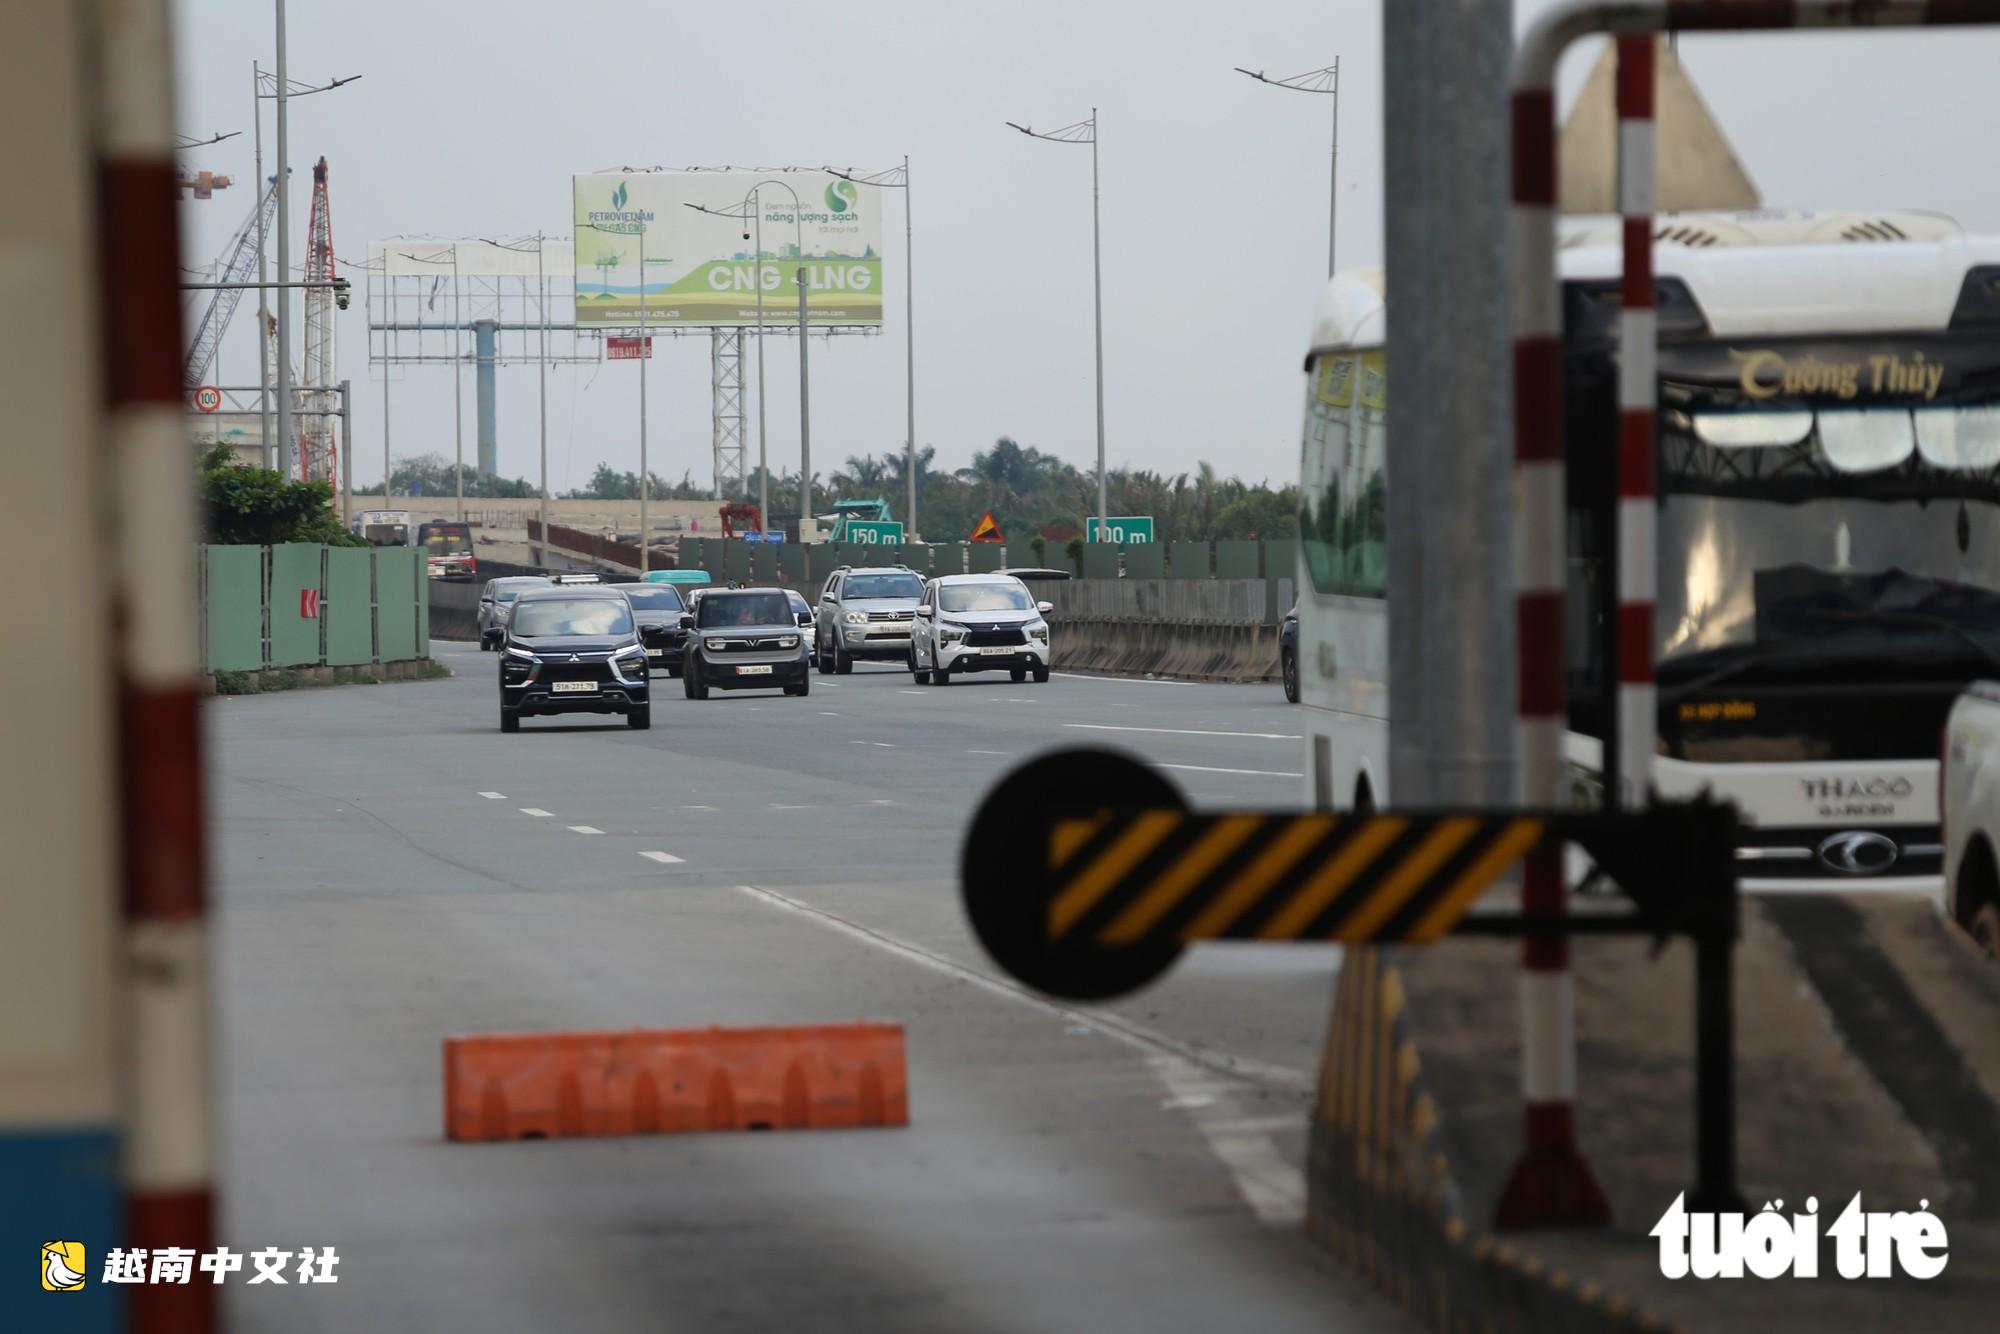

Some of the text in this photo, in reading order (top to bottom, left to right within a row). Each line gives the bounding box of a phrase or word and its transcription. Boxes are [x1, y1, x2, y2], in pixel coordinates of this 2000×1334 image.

[589, 211, 654, 221] PETROVIETNAM
[831, 212, 858, 223] sạch
[708, 265, 781, 290] CNG
[810, 265, 872, 289] LNG
[1729, 348, 1944, 400] Cường Thủy
[201, 392, 216, 405] 100
[852, 528, 897, 544] 150 m
[1130, 532, 1146, 544] m
[1801, 776, 1913, 799] THACO
